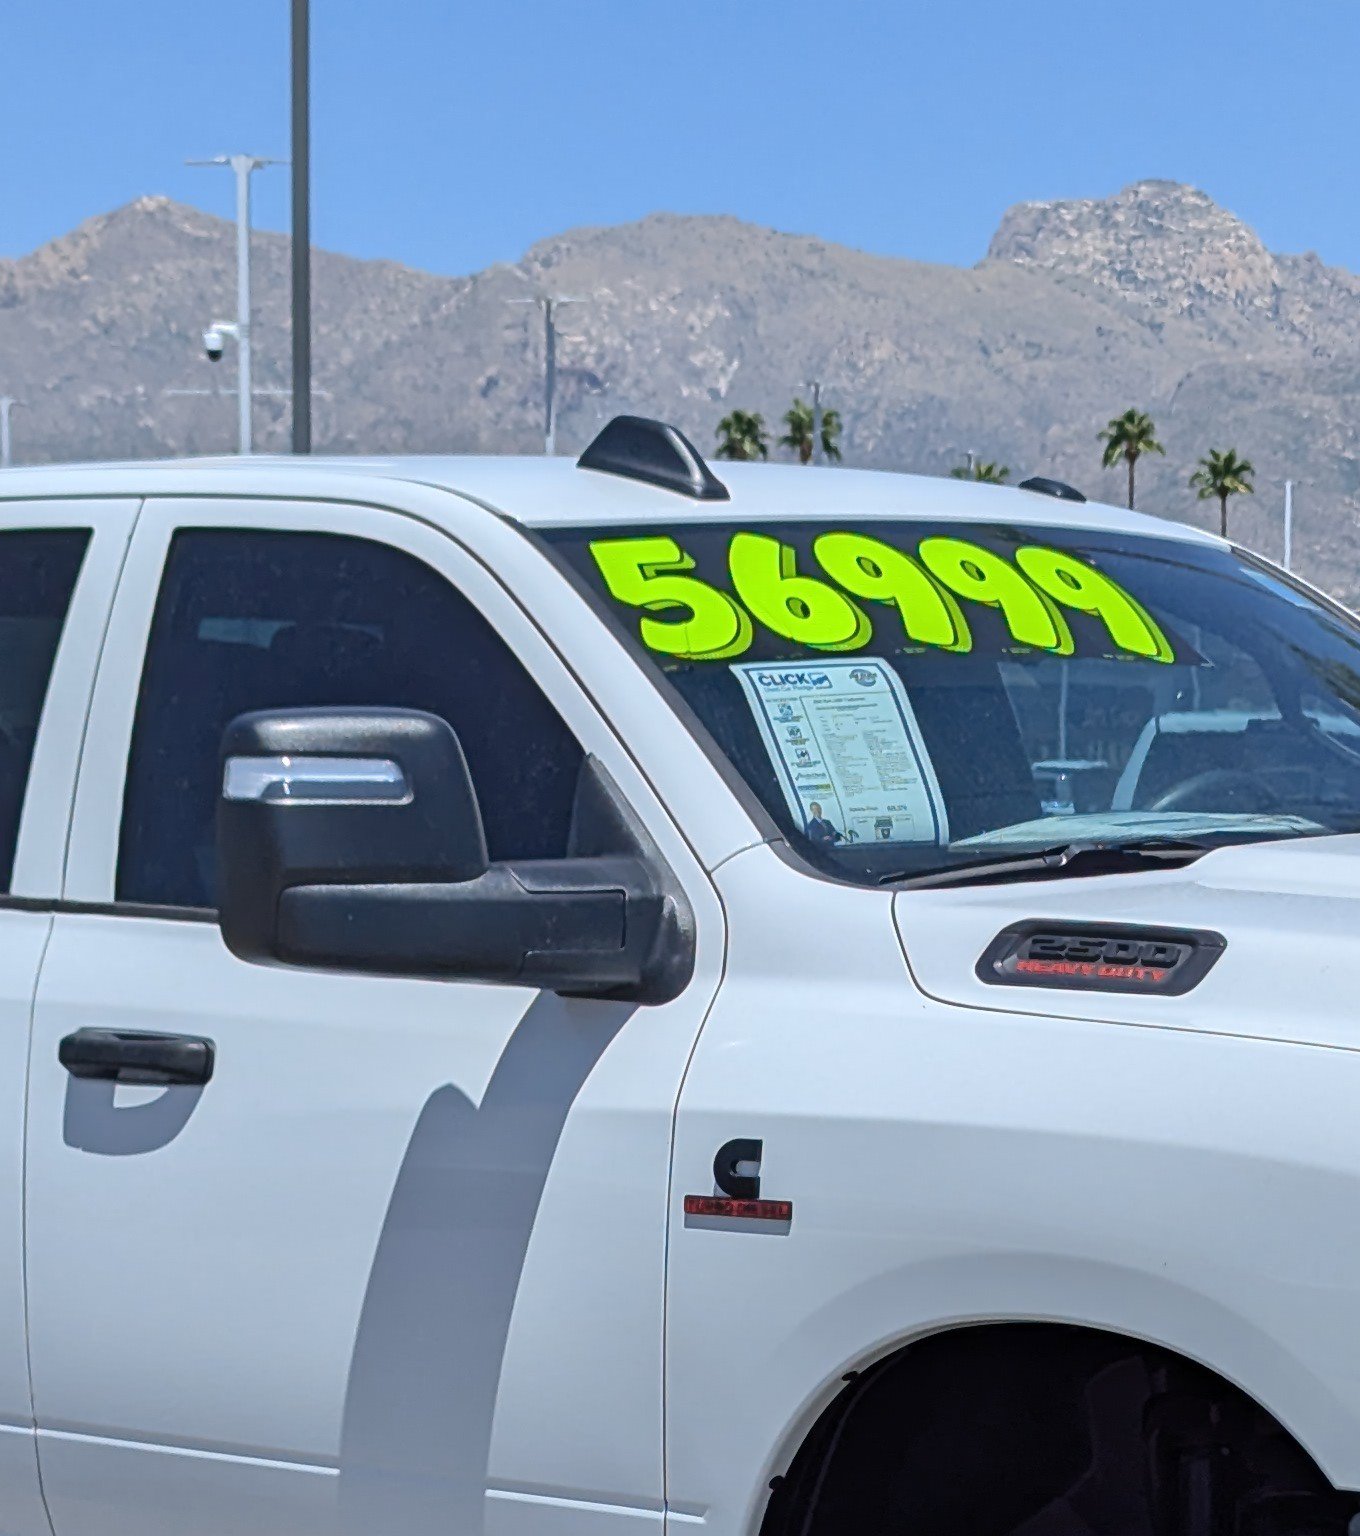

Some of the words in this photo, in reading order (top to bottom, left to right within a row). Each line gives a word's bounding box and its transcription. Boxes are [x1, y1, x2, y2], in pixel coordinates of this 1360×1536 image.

[590, 531, 1174, 664] 56999
[757, 673, 810, 687] CLICK
[1026, 936, 1183, 969] 2500
[1015, 957, 1094, 977] HEAVY
[1097, 963, 1166, 984] DUTY
